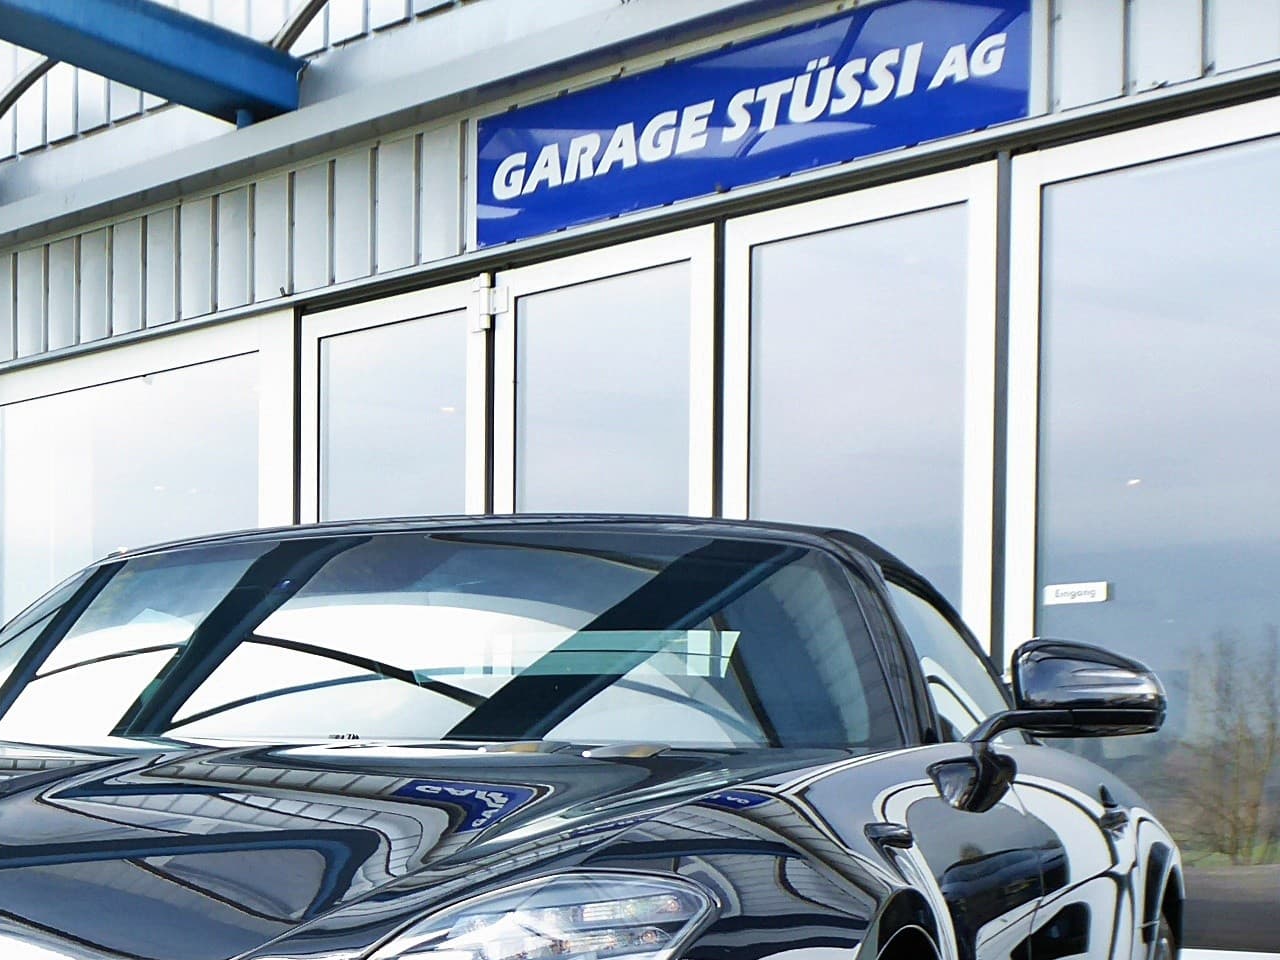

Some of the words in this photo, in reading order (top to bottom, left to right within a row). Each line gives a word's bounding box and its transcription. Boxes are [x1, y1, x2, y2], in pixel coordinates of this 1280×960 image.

[491, 98, 715, 201] GARAGE
[721, 41, 924, 144] STÜSSI
[928, 33, 1008, 91] AG
[1055, 588, 1097, 600] Eingang
